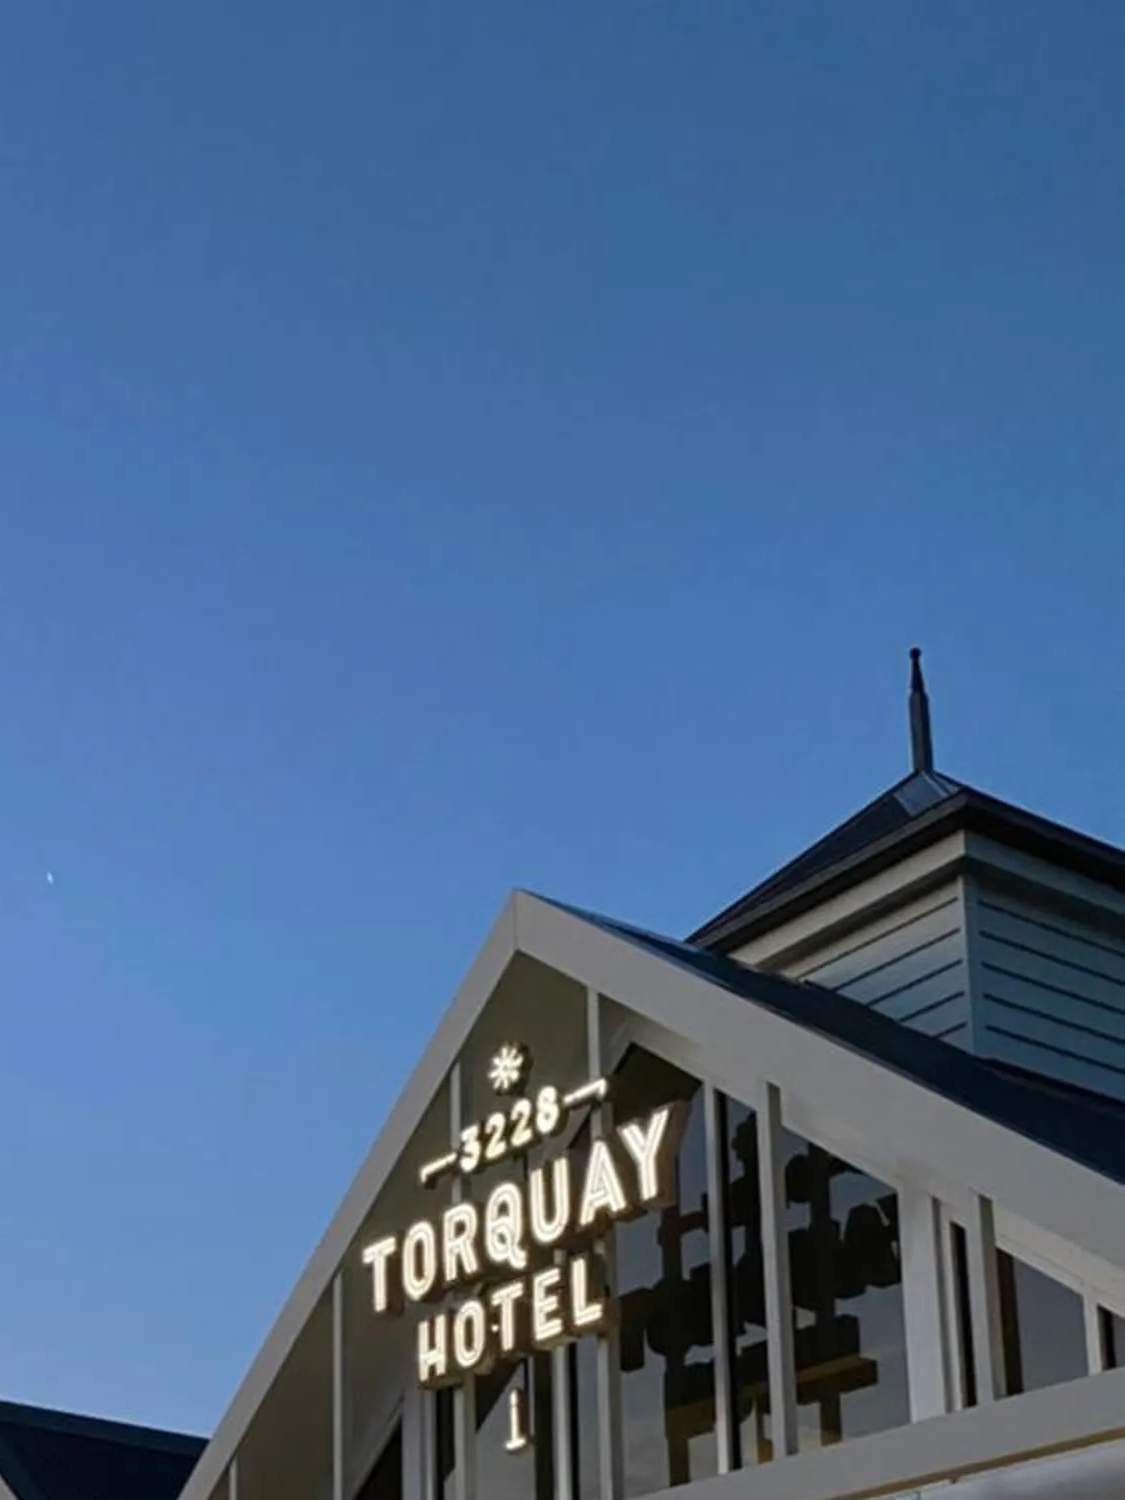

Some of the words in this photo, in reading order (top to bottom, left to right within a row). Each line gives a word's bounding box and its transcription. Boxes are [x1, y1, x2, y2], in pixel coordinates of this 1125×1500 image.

[459, 1085, 559, 1172] 3228
[362, 1108, 671, 1312] TORQUAY
[418, 1257, 603, 1382] HOTEL
